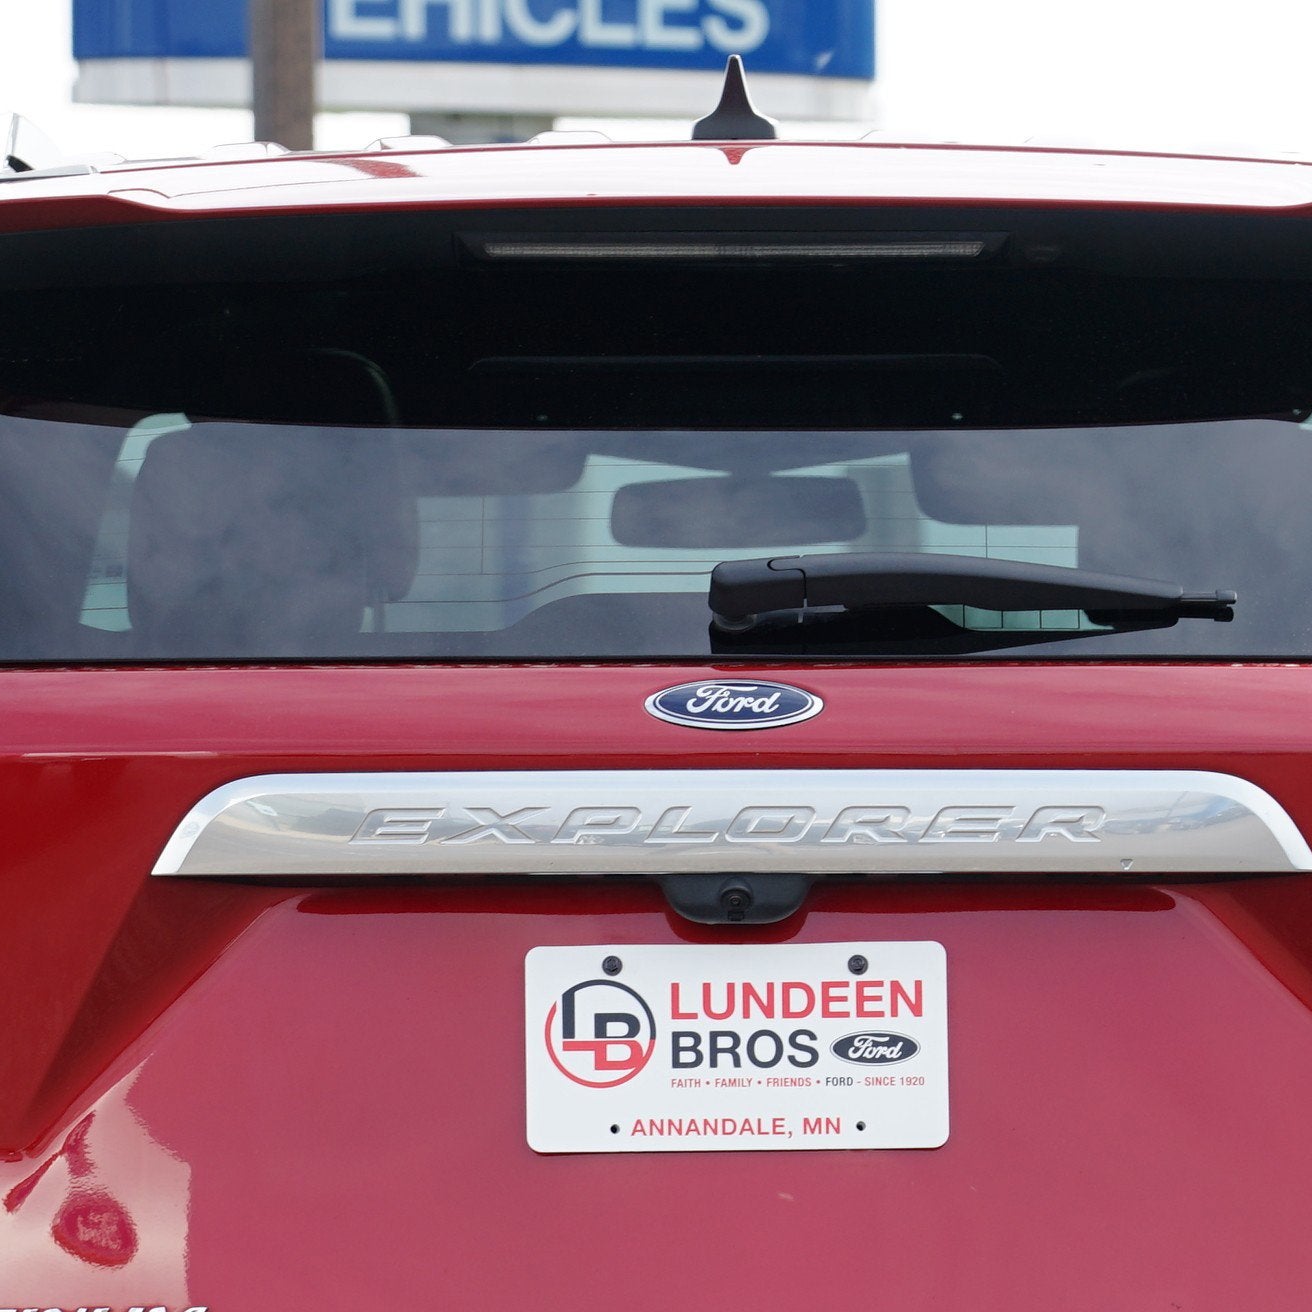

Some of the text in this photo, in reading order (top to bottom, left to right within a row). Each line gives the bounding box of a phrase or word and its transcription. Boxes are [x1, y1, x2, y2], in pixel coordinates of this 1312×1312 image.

[329, 0, 770, 53] EHICLES
[686, 685, 781, 713] Ford
[348, 805, 1108, 845] EXPLORER
[671, 980, 923, 1020] LUNDEEN
[671, 1029, 819, 1069] BROS
[847, 1036, 904, 1060] Ford
[671, 1079, 701, 1088] FAITH
[714, 1078, 753, 1088] FAMILY
[766, 1078, 812, 1087] FRIENDS
[825, 1077, 853, 1087] FORD
[864, 1077, 896, 1086] SINCE
[900, 1077, 925, 1086] 1920
[631, 1116, 841, 1138] ANNANDALE, MN
